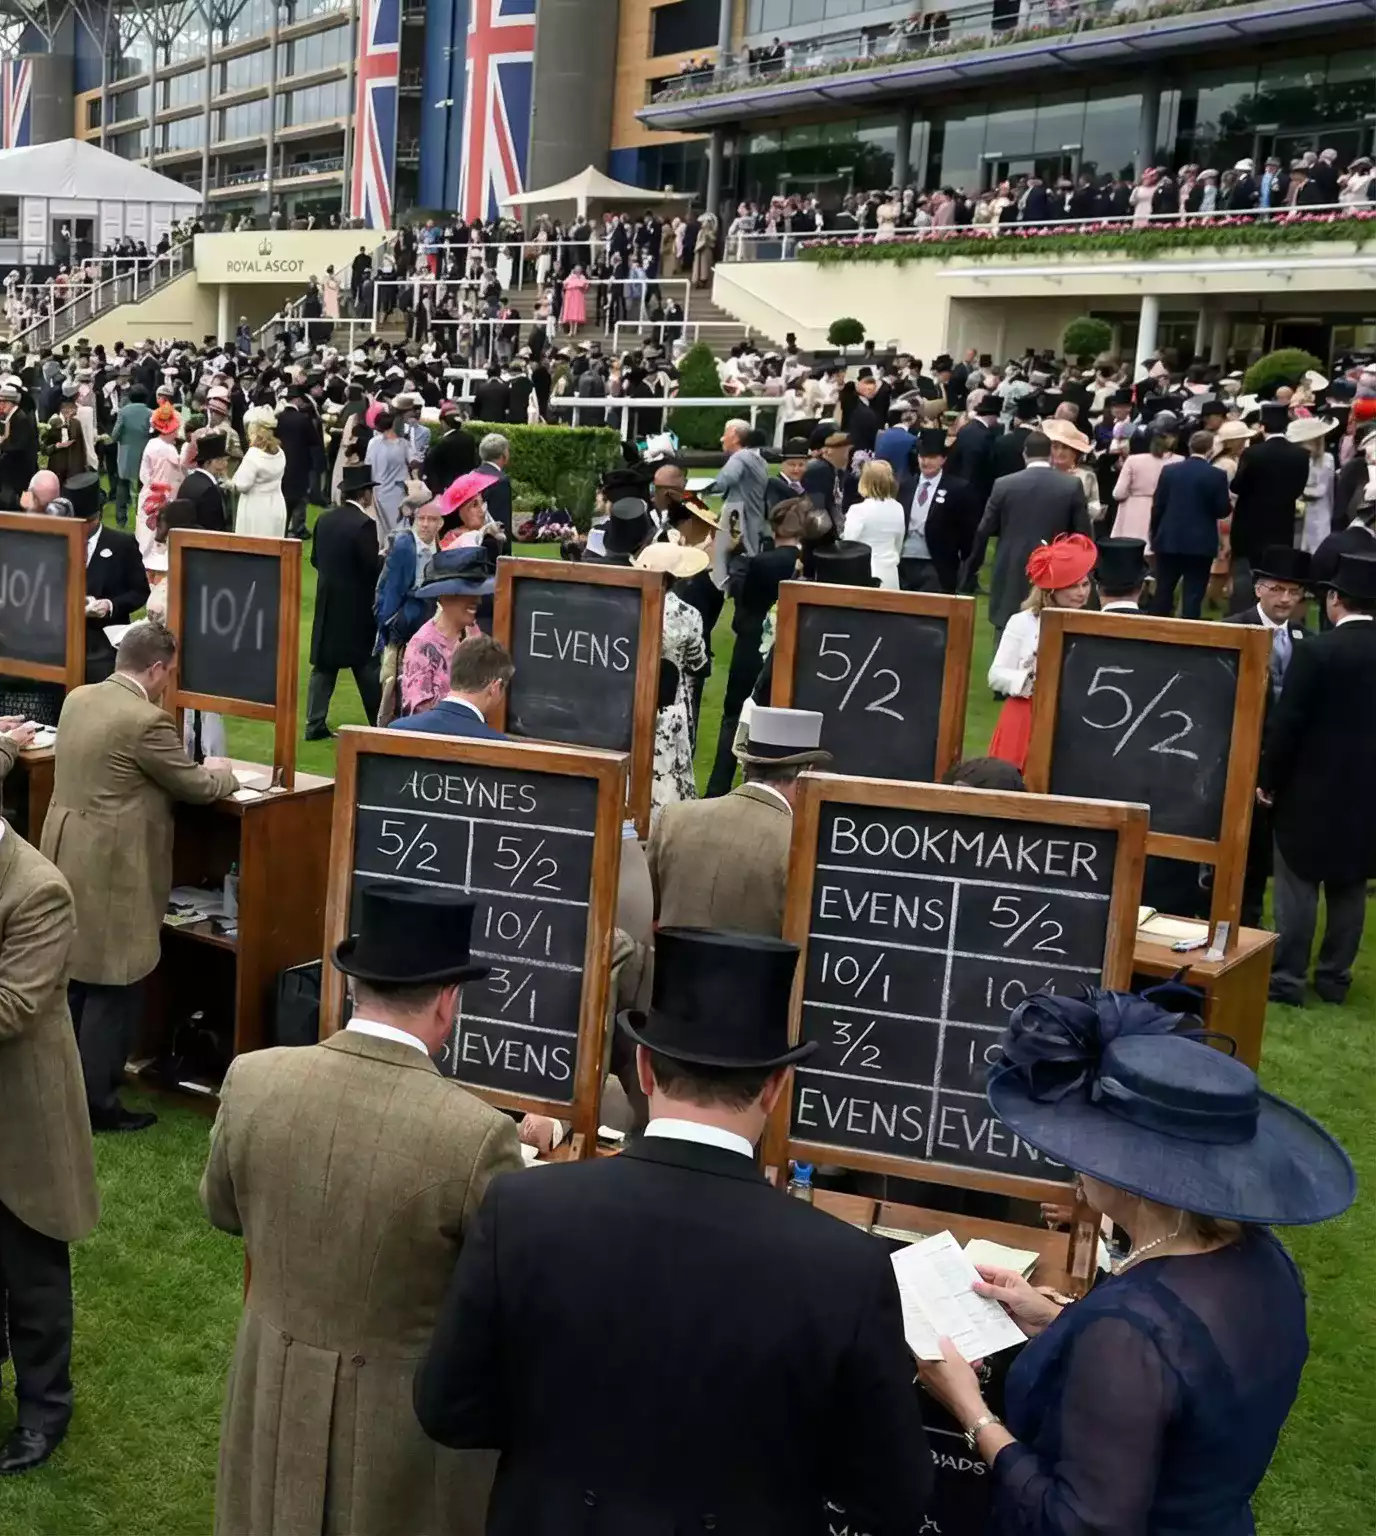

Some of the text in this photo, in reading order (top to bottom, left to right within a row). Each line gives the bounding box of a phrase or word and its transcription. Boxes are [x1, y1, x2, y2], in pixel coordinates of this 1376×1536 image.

[227, 260, 304, 272] ROYAL ASCOT
[0, 562, 50, 624] 10/1
[201, 580, 264, 651] 10/1
[816, 633, 904, 721] 5/2
[1082, 665, 1199, 760] 5/2
[377, 819, 561, 891] 5/2 5/2
[830, 817, 1099, 881] BOOKMAKER
[484, 906, 552, 956] 10/1
[819, 885, 1068, 954] EVENS 5/2
[488, 967, 535, 1022] 3/1
[821, 952, 890, 1002] 10/1
[462, 1032, 571, 1081] EVENS
[832, 1020, 882, 1069] 3/2
[797, 1087, 1066, 1167] EVENS EVEN
